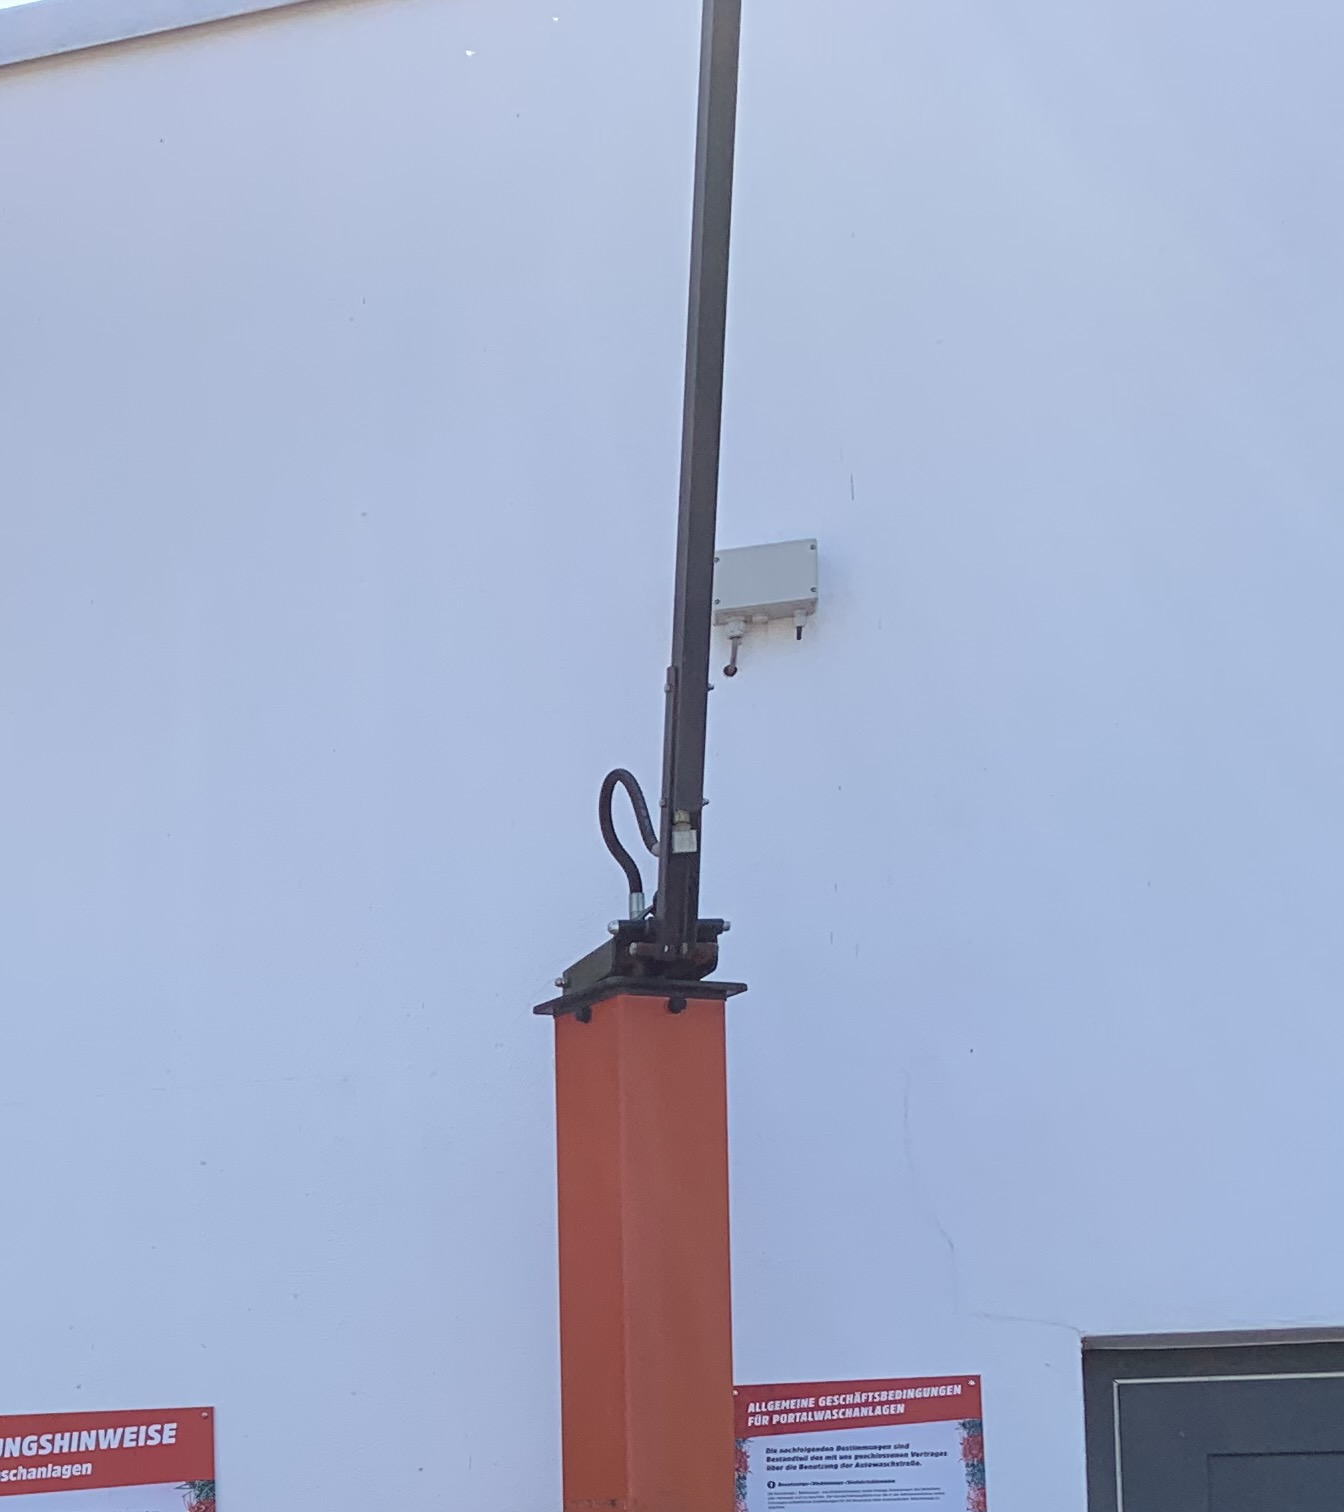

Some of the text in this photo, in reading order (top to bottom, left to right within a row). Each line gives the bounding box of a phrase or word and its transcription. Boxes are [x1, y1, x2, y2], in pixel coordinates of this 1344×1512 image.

[748, 1385, 962, 1413] ALLGEMEINE GESCHÄFTSBEDINGUNGEN
[748, 1403, 905, 1426] FÜR PORTALWASCHANLAGEN
